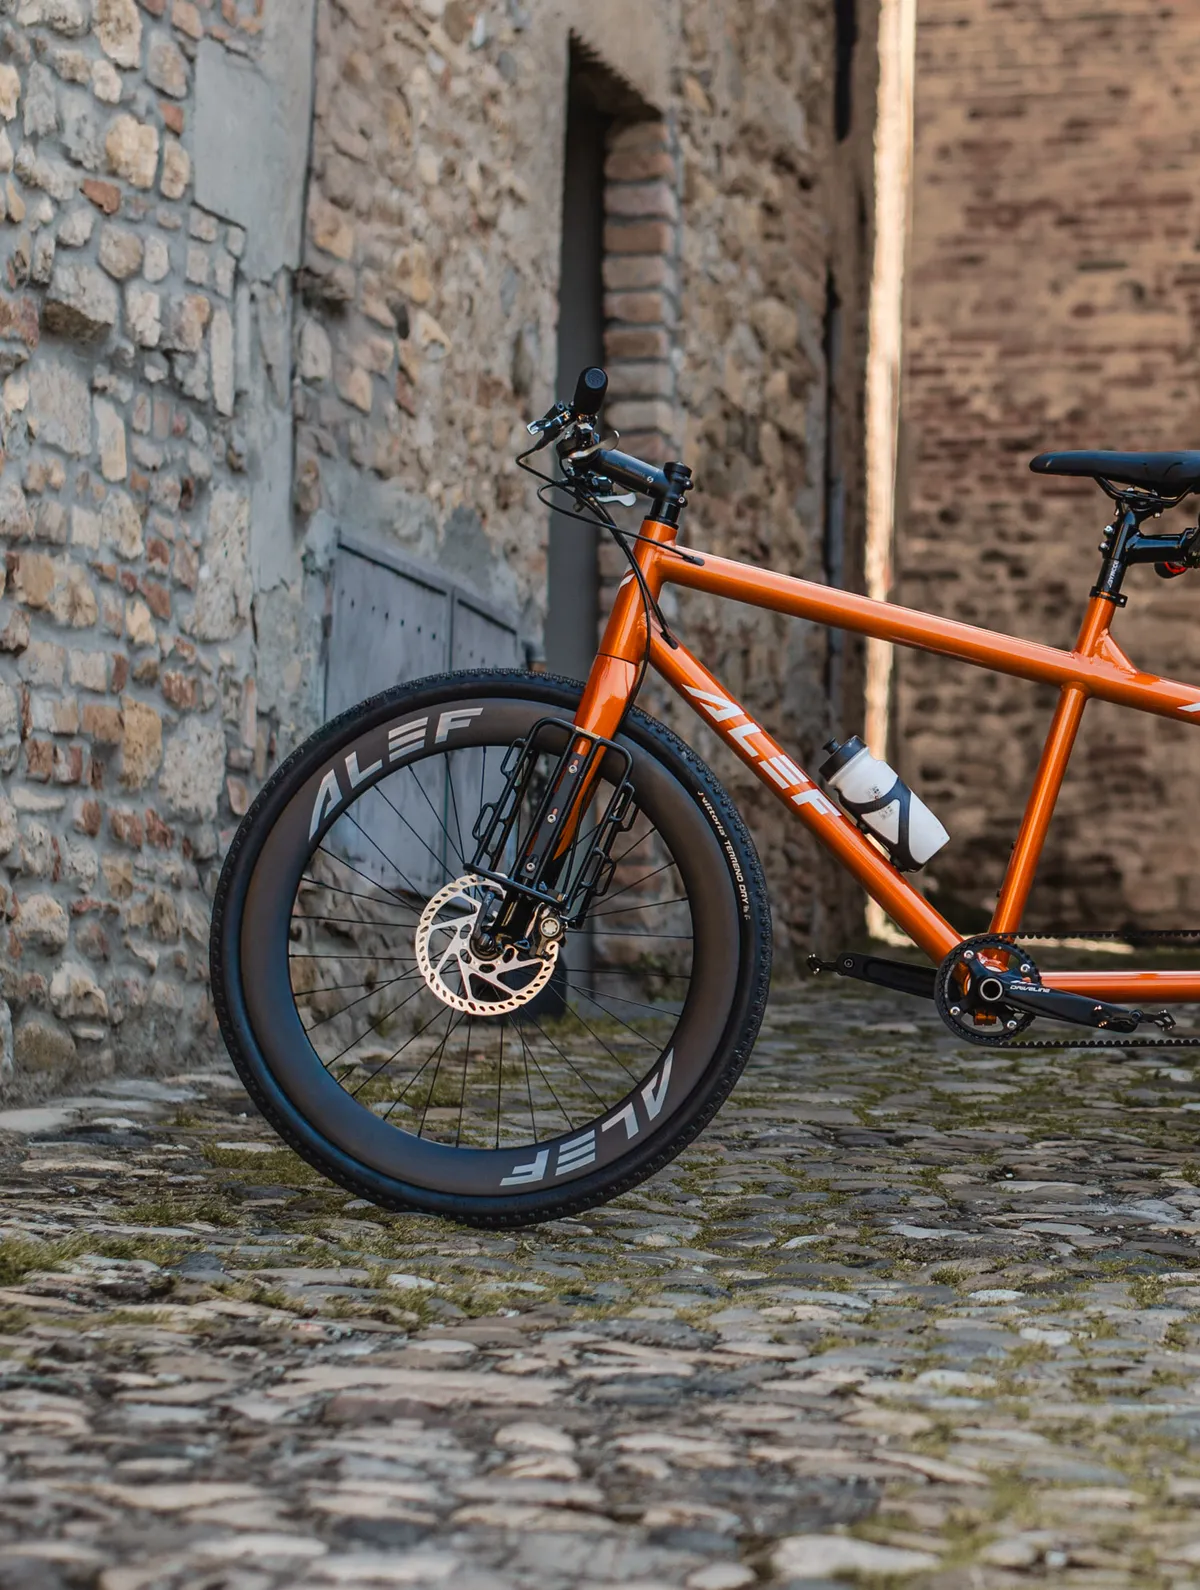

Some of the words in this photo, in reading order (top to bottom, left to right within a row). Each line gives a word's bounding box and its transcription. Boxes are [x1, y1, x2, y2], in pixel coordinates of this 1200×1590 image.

[309, 707, 484, 842] ALEF
[681, 683, 842, 817] ALEF
[701, 796, 727, 837] vittoria
[724, 840, 744, 882] TERRENO
[739, 884, 749, 904] DRY
[500, 1048, 674, 1186] ALEF
